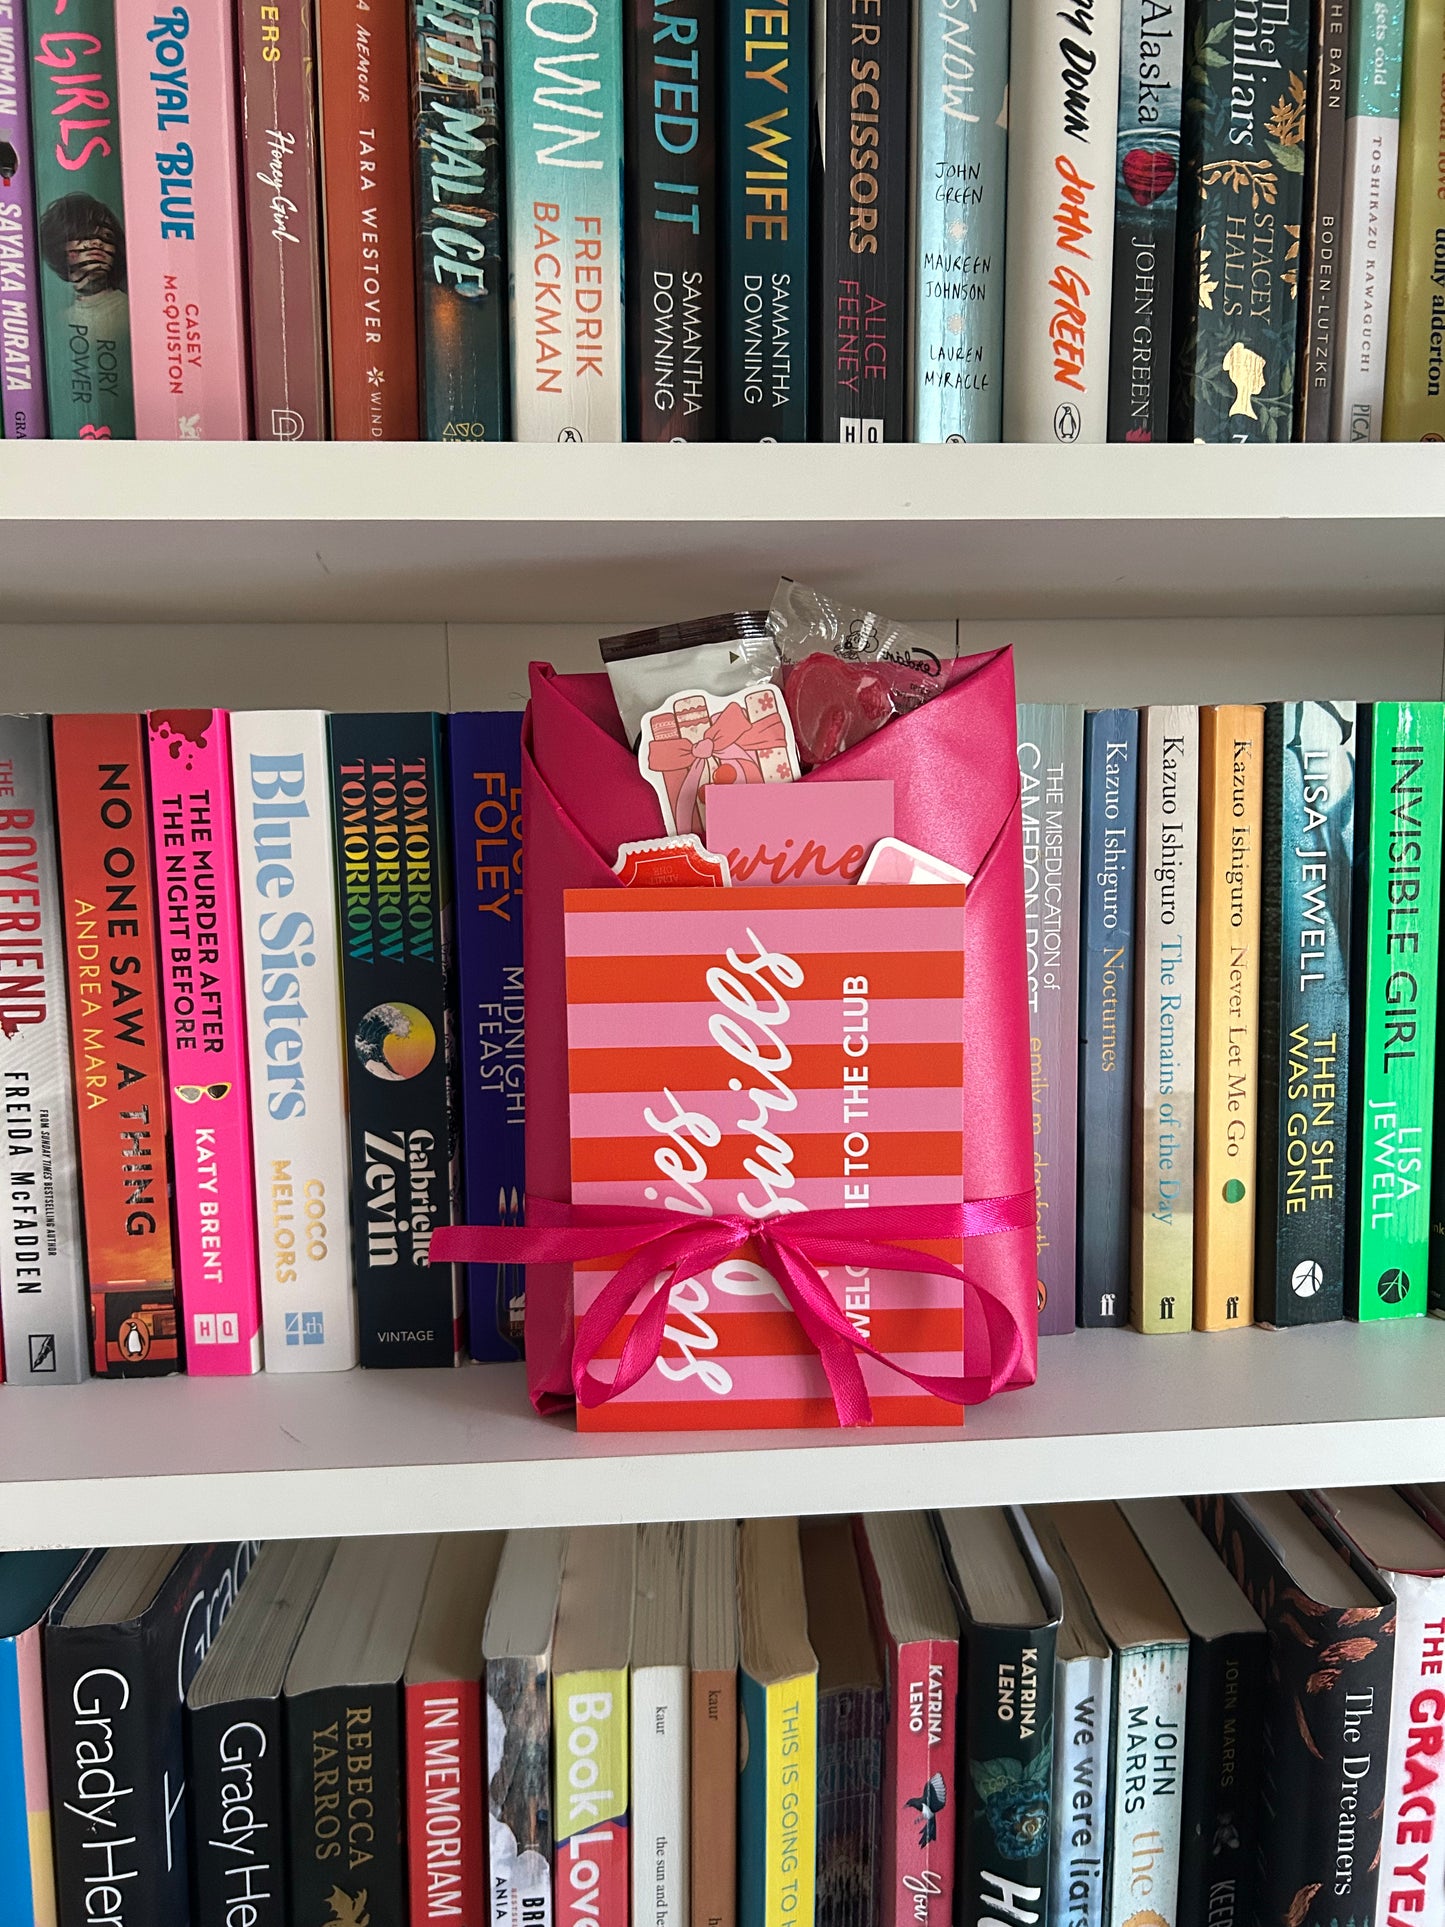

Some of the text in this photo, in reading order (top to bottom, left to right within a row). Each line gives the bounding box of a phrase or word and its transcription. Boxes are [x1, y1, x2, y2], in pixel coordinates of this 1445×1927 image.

[356, 23, 371, 104] MEMOIR
[1060, 37, 1098, 145] DOWN
[1138, 0, 1174, 125] Alaska
[1261, 0, 1291, 54] The
[1327, 48, 1342, 109] BARN
[1372, 3, 1388, 85] gets cold
[34, 31, 111, 171] GIRLS
[146, 6, 195, 241] ROYAL BLUE
[849, 59, 880, 254] SCISSORS
[256, 129, 301, 243] Honey Girl
[358, 128, 381, 344] TARA WESTOVER
[431, 101, 488, 291] MALICE
[654, 181, 700, 235] IT
[744, 108, 791, 241] WIFE
[935, 162, 981, 180] JOHN
[935, 186, 983, 204] GREEN
[0, 202, 33, 392] SAYAKA MURATA
[533, 200, 562, 394] BACKMAN
[575, 216, 604, 378] FREDRIK
[925, 253, 992, 272] MAUREEN
[926, 281, 987, 300] JOHNSON
[1048, 155, 1096, 394] JOHN GREEN
[1222, 214, 1248, 317] HALLS
[1250, 212, 1276, 326] STACEY
[1314, 216, 1335, 389] BODEN-LUTZKE
[1360, 136, 1383, 374] TOSHIKAZU KAWAGUCHI
[69, 323, 92, 404] POWER
[97, 339, 119, 398] RORY
[162, 275, 183, 395] McQUISTON
[185, 303, 202, 368] CASEY
[653, 271, 674, 411] DOWNING
[682, 271, 703, 416] SAMANTHA
[743, 275, 763, 404] DOWNING
[771, 273, 791, 407] SAMANTHA
[837, 280, 860, 393] FEENEY
[863, 295, 887, 380] ALICE
[925, 372, 991, 392] MYRACLE
[930, 345, 984, 362] LAUREN
[1130, 237, 1156, 419] JOHN GREEN
[1428, 295, 1445, 397] alderton
[340, 758, 374, 964] TOMORROW
[370, 758, 404, 964] TOMORROW
[402, 757, 435, 964] TOMORROW
[472, 771, 511, 921] FOLEY
[721, 839, 864, 884] wine
[1043, 763, 1064, 990] THE MISEDUCATION of
[1097, 741, 1128, 1072] Kazuo Ishiguro Nocturnes
[1295, 750, 1329, 992] LISA JEWELL
[1384, 745, 1424, 1074] INVISIBLE GIRL
[0, 808, 46, 1025] BOYFRIEND
[162, 794, 197, 1050] THE NIGHT BEFORE
[189, 789, 225, 1054] THE MURDER AFTER
[250, 753, 316, 1121] Blue Sisters
[1152, 735, 1185, 1226] Kazuo Ishiguro The Remains of the Day
[1225, 739, 1253, 1157] Kazuo Ishiguro Never Let Me Go
[74, 899, 108, 1110] ANDREA MARA
[98, 764, 156, 1236] NO ONE SAW A THING
[479, 1003, 504, 1093] FEAST
[502, 966, 525, 1124] MIDNIGHT
[706, 926, 809, 1219] swills
[843, 975, 869, 1175] TO THE CLUB
[1286, 1023, 1309, 1215] WAS GONE
[1310, 1032, 1337, 1201] THEN SHE
[4, 1072, 42, 1294] FREIDA McFADDEN
[39, 1110, 57, 1256] FROM SUNDAY TIMES BESTSELLING AUTHOR
[196, 1128, 223, 1284] KATY BRENT
[271, 1160, 298, 1284] MELLORS
[303, 1179, 328, 1262] COCO
[364, 1130, 409, 1268] Zevin
[1368, 1099, 1398, 1229] JEWELL
[1396, 1127, 1423, 1200] LISA
[376, 1331, 435, 1342] VINTAGE
[63, 1668, 134, 1827] Grady
[568, 1691, 614, 1820] Book
[656, 1706, 668, 1735] kaur
[708, 1690, 722, 1721] kaur
[909, 1681, 923, 1732] LENO
[928, 1664, 943, 1745] KATRINA
[997, 1664, 1015, 1720] LENO
[1019, 1648, 1038, 1739] KATRINA
[1152, 1715, 1178, 1796] JOHN
[1221, 1660, 1239, 1788] JOHN MARRS
[1396, 1618, 1445, 1845] THE GRACE
[208, 1722, 268, 1855] Grady
[313, 1721, 341, 1860] YARROS
[346, 1705, 374, 1870] REBECCA
[424, 1698, 462, 1918] IN MEMORIAM
[781, 1701, 799, 1912] THIS IS GOING TO
[1071, 1696, 1095, 1848] we were
[1125, 1705, 1148, 1814] MARRS
[1334, 1687, 1374, 1895] The Dreamers
[495, 1877, 507, 1920] ANIA
[656, 1836, 668, 1908] the sun and
[903, 1870, 942, 1922] You
[1130, 1828, 1164, 1896] the
